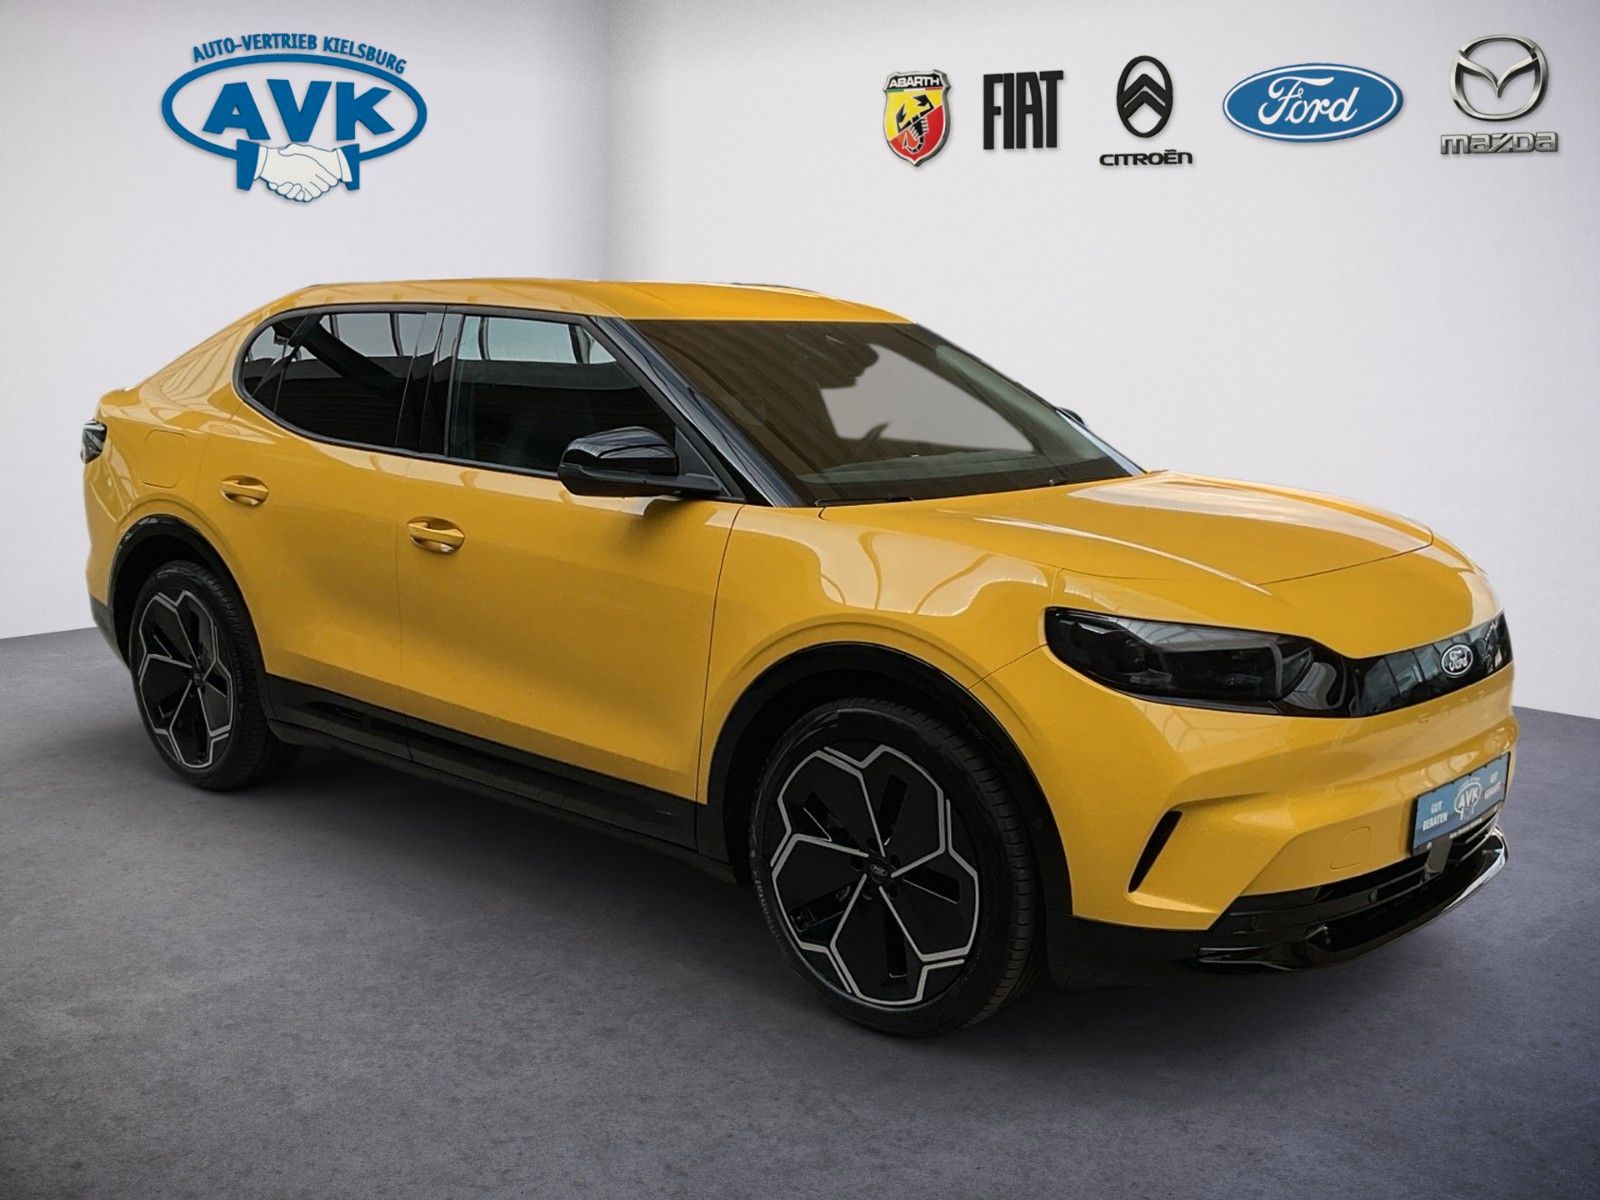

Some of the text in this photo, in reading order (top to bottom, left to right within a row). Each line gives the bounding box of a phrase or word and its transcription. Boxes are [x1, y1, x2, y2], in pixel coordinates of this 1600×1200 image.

[192, 33, 407, 75] AUTO-VERTRIEB KIELSBURG
[888, 76, 941, 89] ABARTH
[201, 78, 396, 143] AVK
[983, 70, 1064, 150] FIAT
[1257, 76, 1360, 126] Ford
[1449, 649, 1469, 672] Ford
[1430, 800, 1443, 814] GUT
[1458, 787, 1478, 809] AVK
